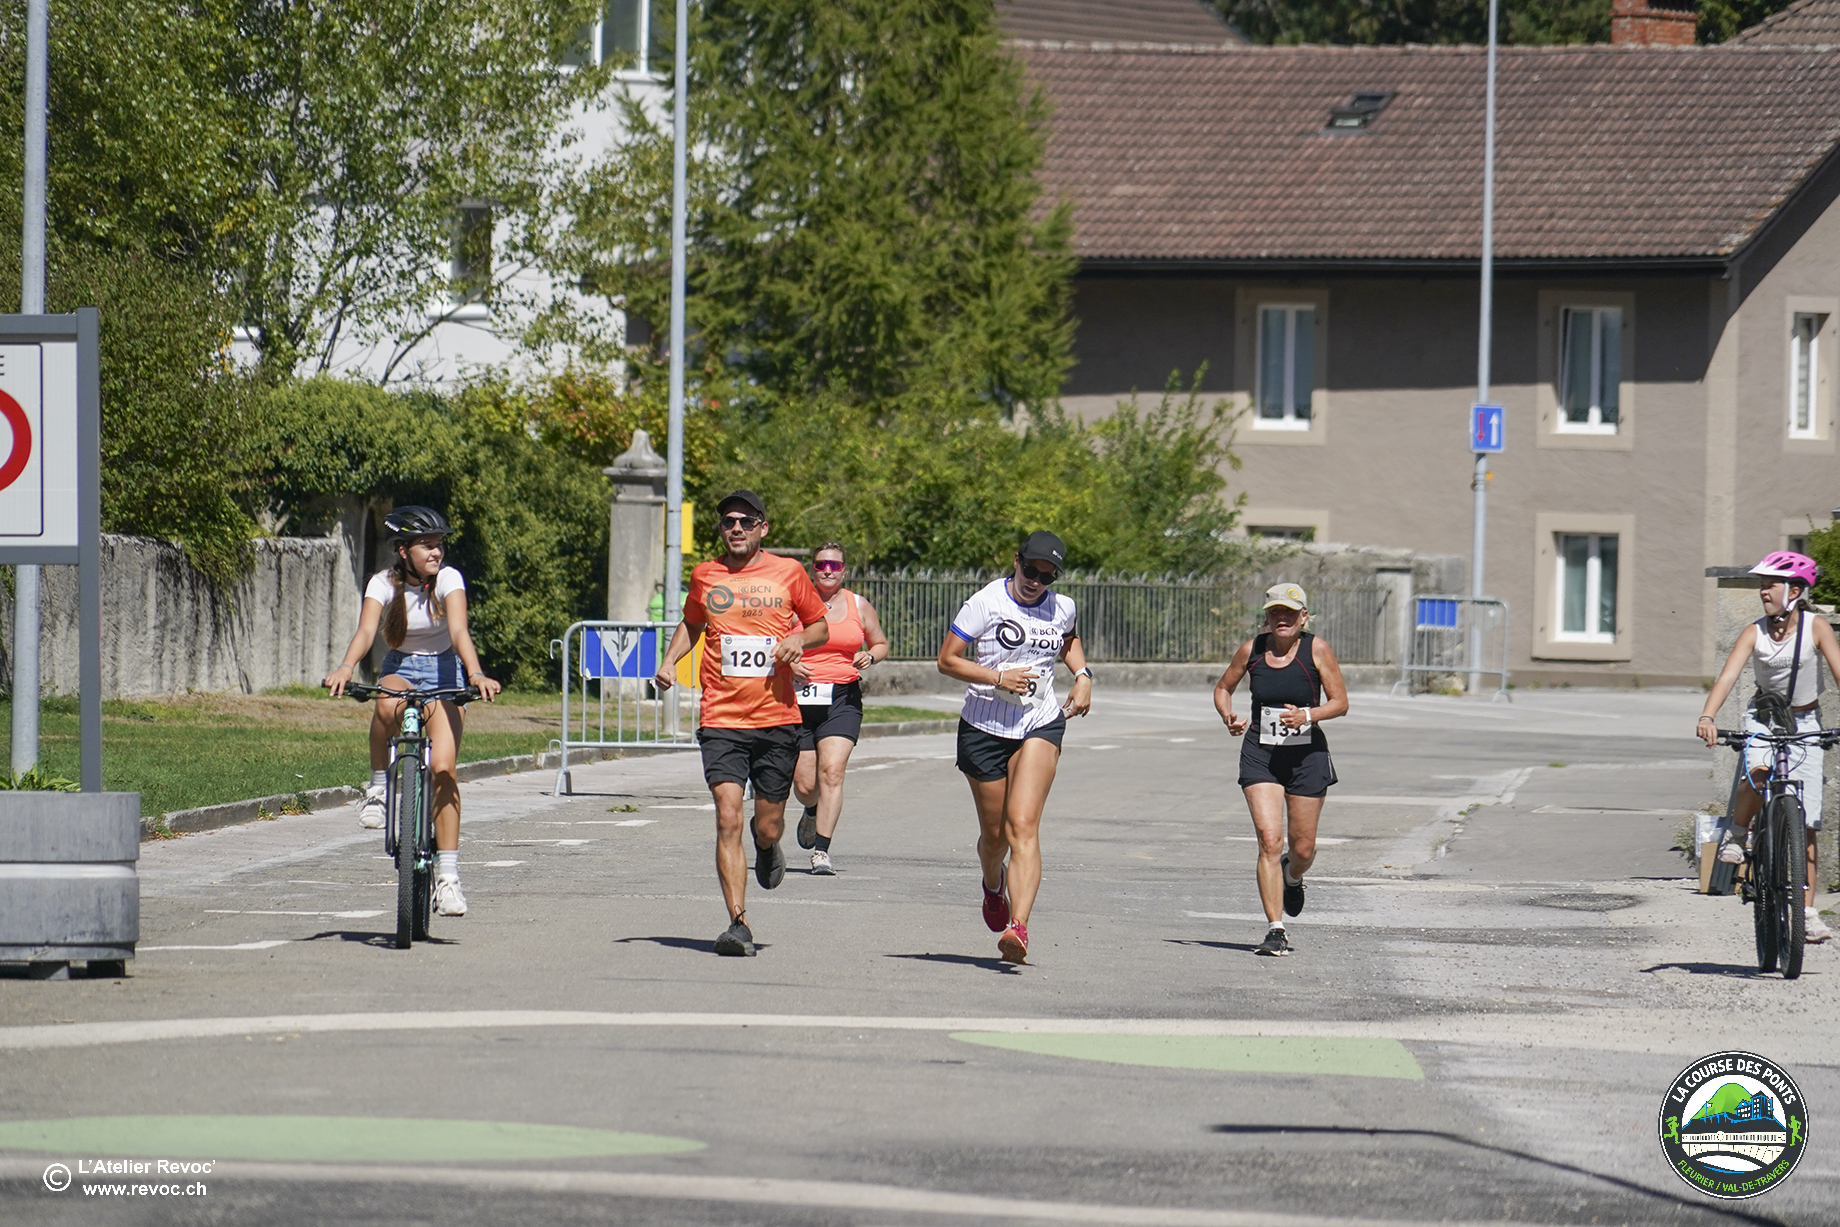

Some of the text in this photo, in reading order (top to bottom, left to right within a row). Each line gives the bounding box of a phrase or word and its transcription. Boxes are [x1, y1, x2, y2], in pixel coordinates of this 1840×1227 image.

[739, 597, 783, 608] TOUR
[742, 609, 763, 618] 2025
[1039, 627, 1058, 636] BCN
[730, 650, 767, 668] 120
[801, 684, 819, 698] 81
